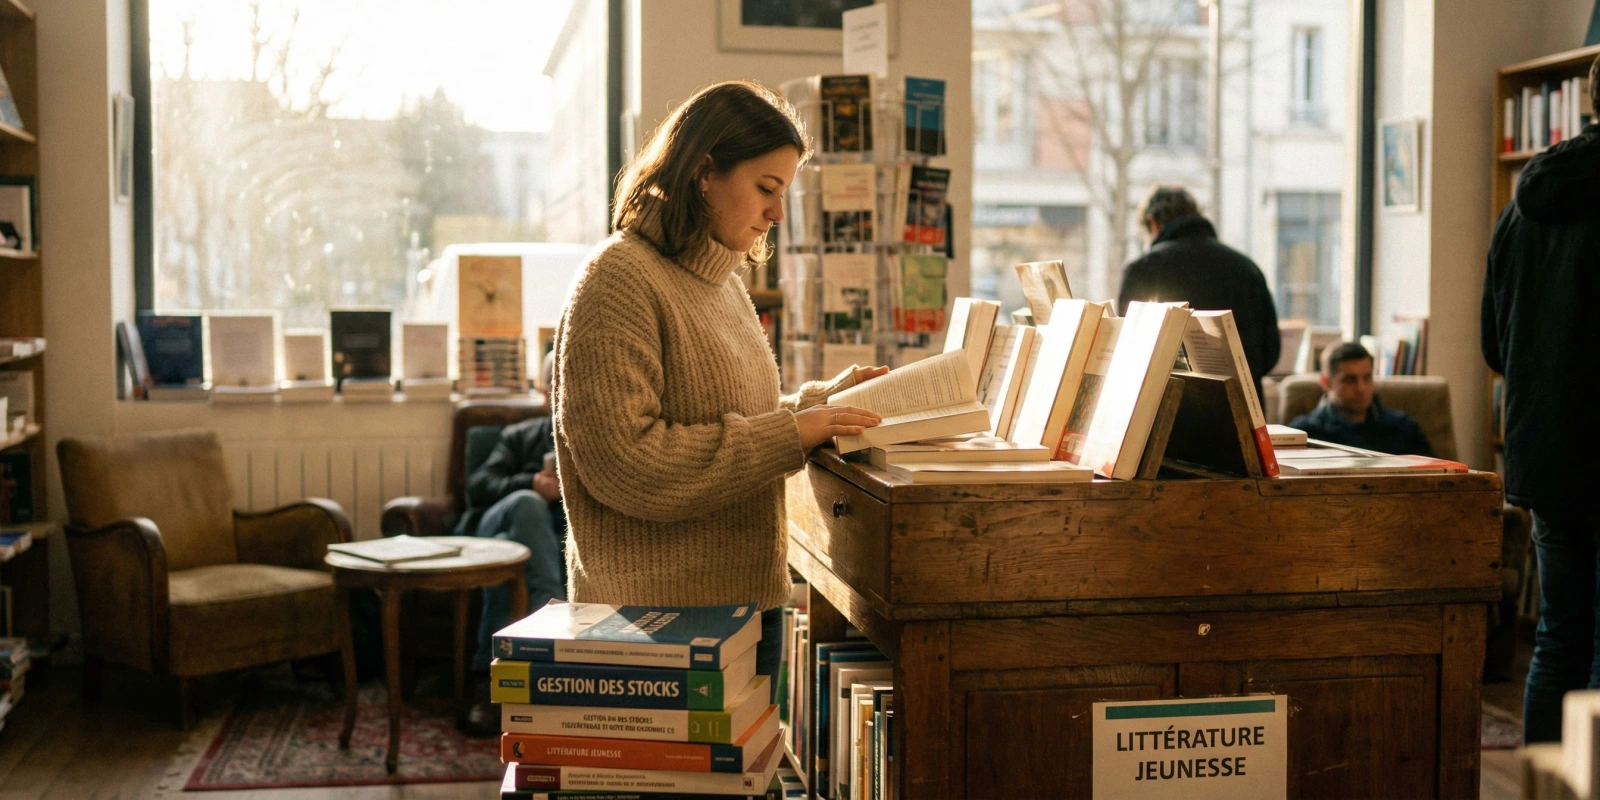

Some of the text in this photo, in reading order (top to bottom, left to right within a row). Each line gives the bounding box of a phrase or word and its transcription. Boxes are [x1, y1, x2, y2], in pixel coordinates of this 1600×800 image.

[537, 677, 595, 694] GESTION
[598, 679, 625, 696] DES
[627, 680, 680, 697] STOCKS
[1117, 725, 1265, 752] LITTÉRATURE
[546, 746, 622, 758] LITTÉRATURE JEUNESSE
[1134, 756, 1246, 781] JEUNESSE
